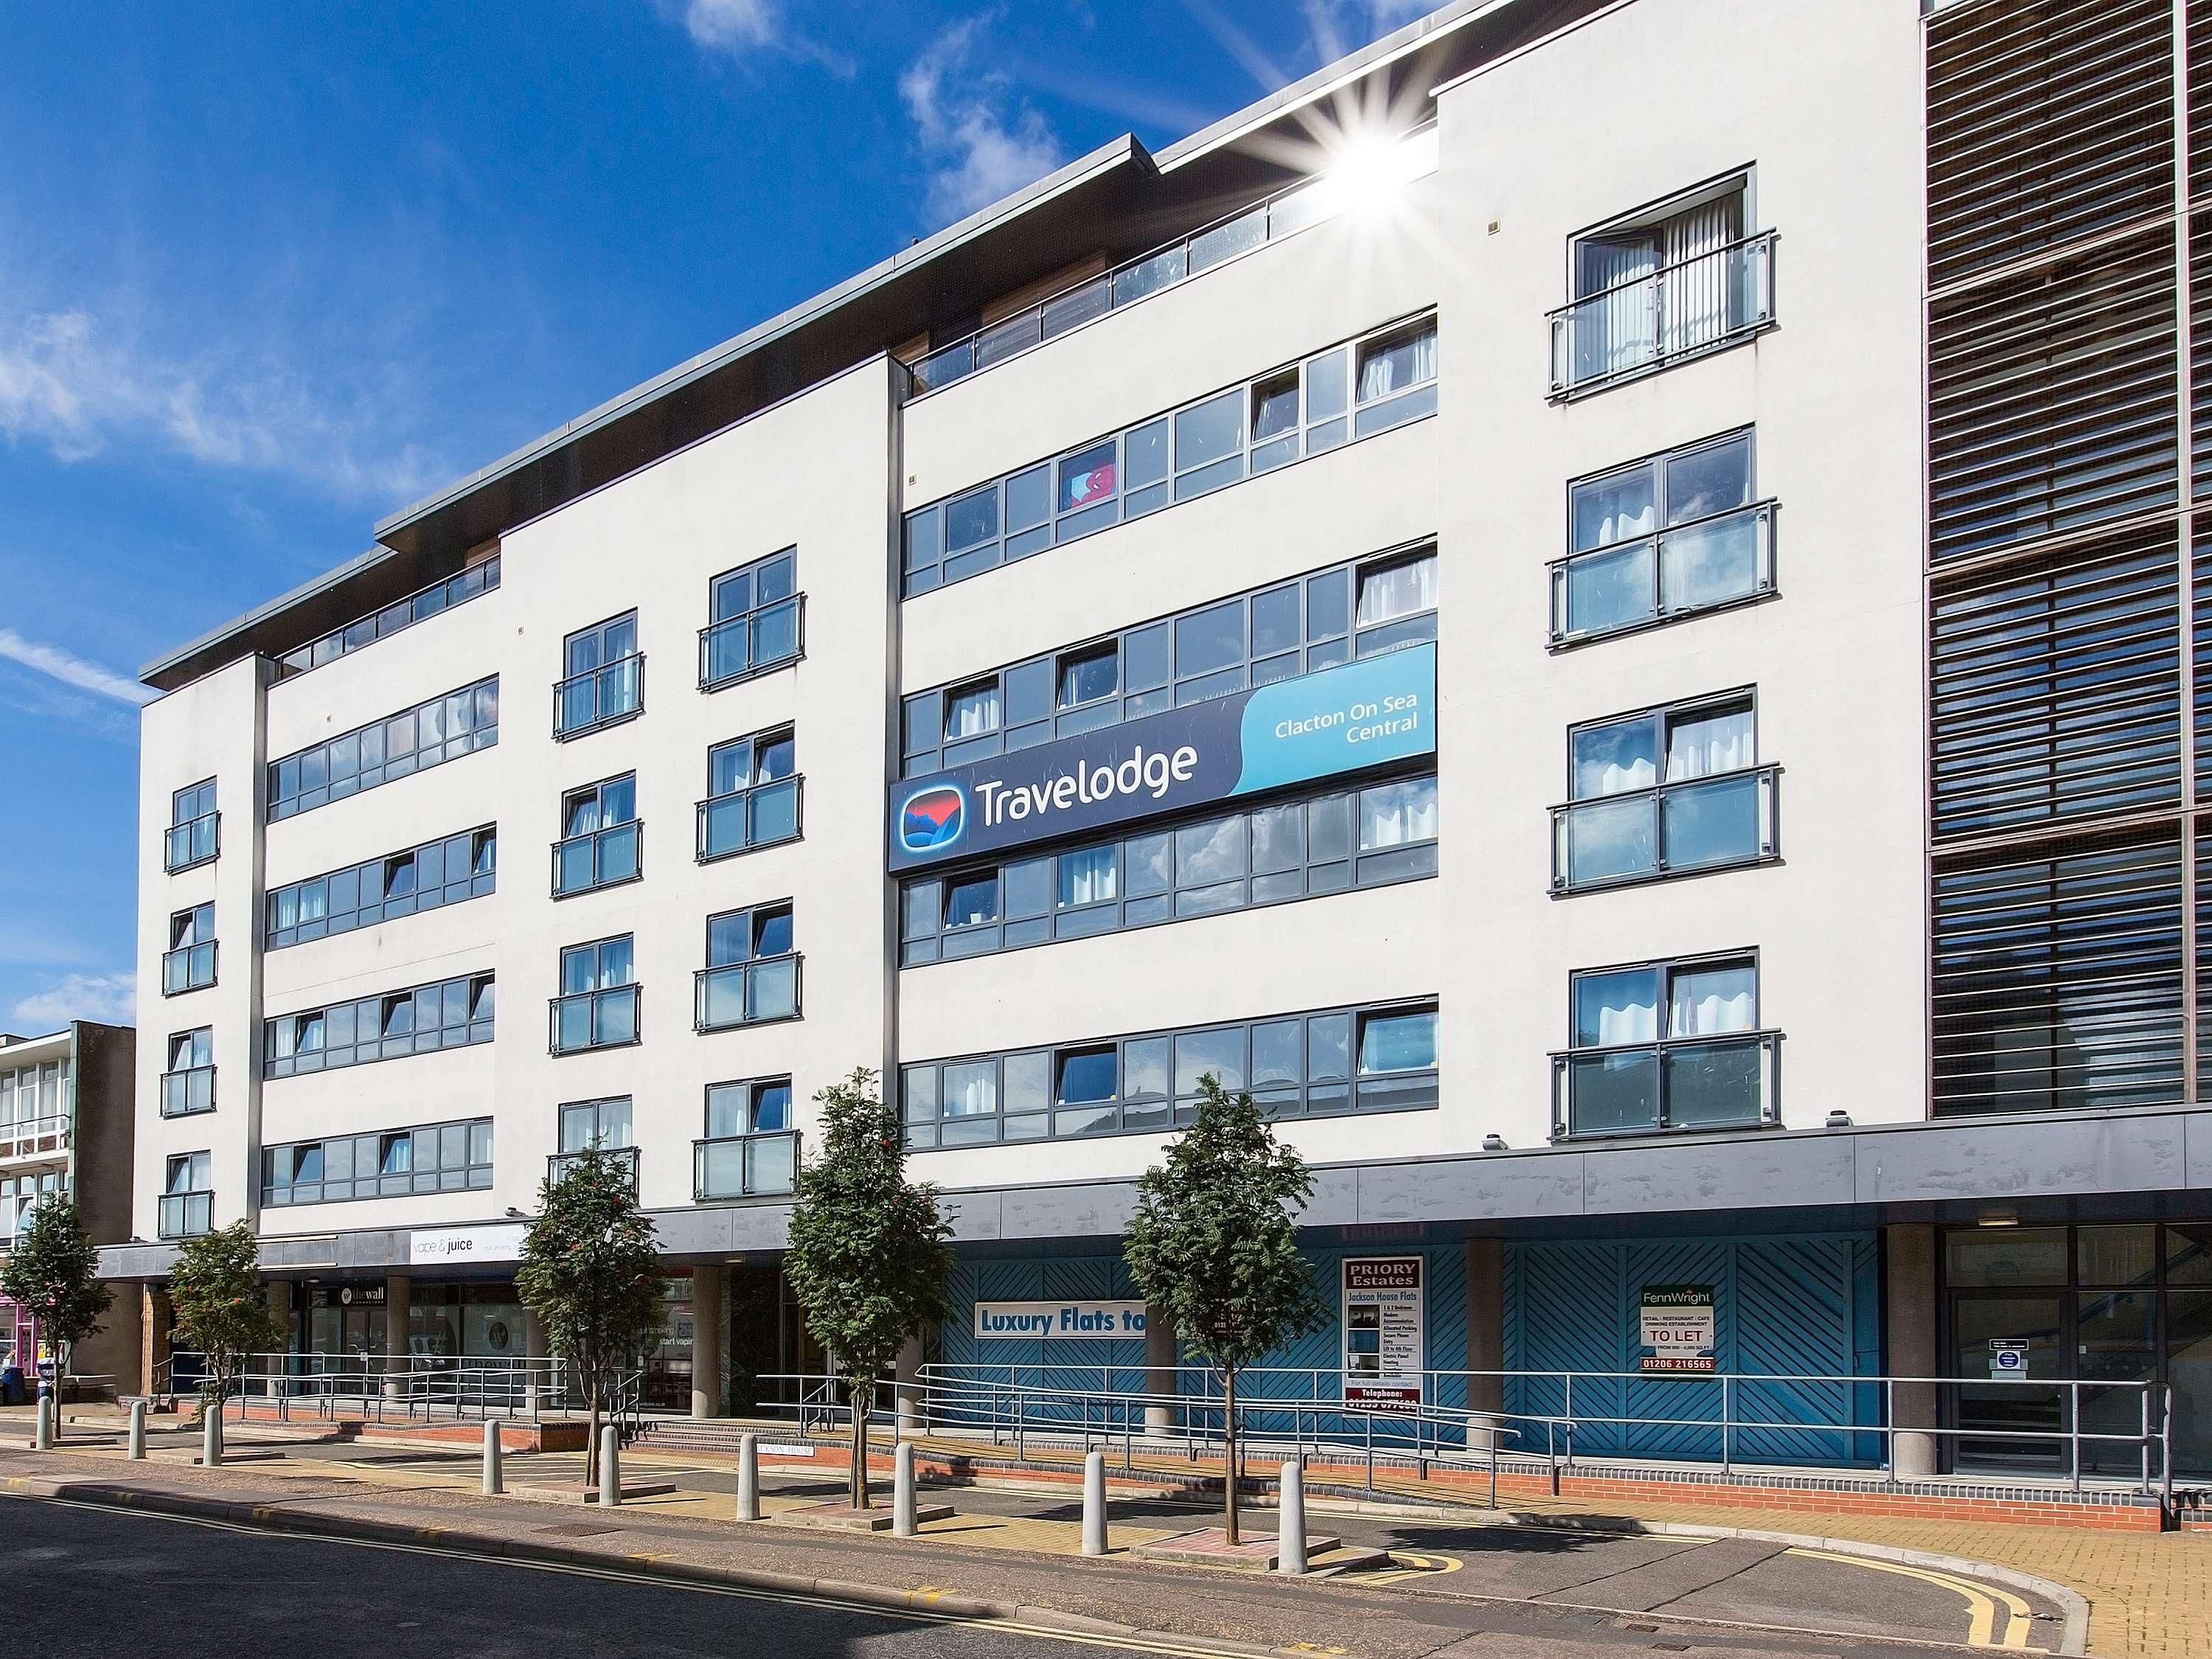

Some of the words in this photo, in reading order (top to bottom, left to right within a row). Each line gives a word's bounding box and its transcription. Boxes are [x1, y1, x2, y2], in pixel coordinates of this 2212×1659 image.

[1274, 712, 1345, 740] Clacton
[1350, 702, 1379, 720] On
[1383, 692, 1417, 714] Sea
[1346, 712, 1418, 744] Central
[975, 745, 1198, 827] Travelodge
[447, 1237, 473, 1254] juice
[1350, 1264, 1416, 1276] PRIORY
[1352, 1276, 1414, 1287] Estates
[1349, 1292, 1375, 1301] Jackson
[1377, 1291, 1399, 1301] House
[1400, 1290, 1417, 1301] Flats
[1643, 1292, 1711, 1304] FennWright
[981, 1309, 1054, 1336] Luxury
[1060, 1307, 1115, 1332] Flats
[1121, 1310, 1146, 1332] to
[659, 1338, 675, 1346] start
[1649, 1330, 1670, 1342] TO
[1674, 1330, 1703, 1342] LET
[1644, 1360, 1672, 1368] 01206
[1675, 1360, 1711, 1368] 216565
[1361, 1388, 1402, 1399] Telephone:
